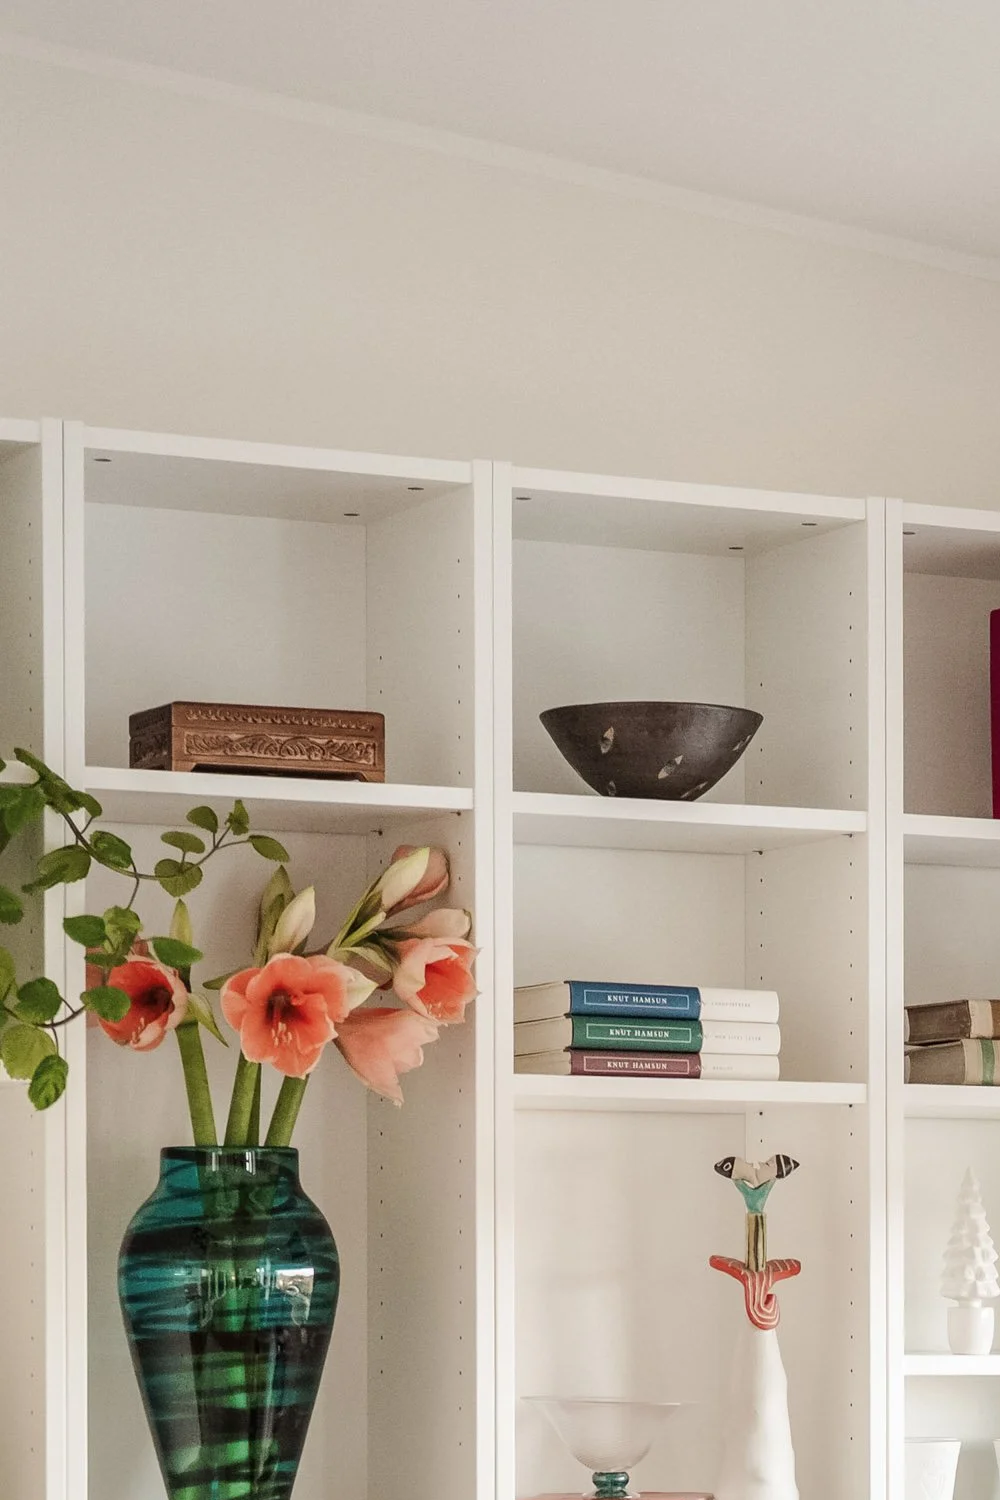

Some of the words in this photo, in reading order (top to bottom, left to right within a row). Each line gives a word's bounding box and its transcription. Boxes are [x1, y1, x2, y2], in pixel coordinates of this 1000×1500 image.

[607, 995, 629, 1004] KNUT
[632, 995, 668, 1005] HAMSUN
[609, 1028, 632, 1037] KNUT
[634, 1029, 670, 1038] HAMSUN
[607, 1061, 629, 1069] KNUT
[632, 1062, 668, 1070] HAMSUN
